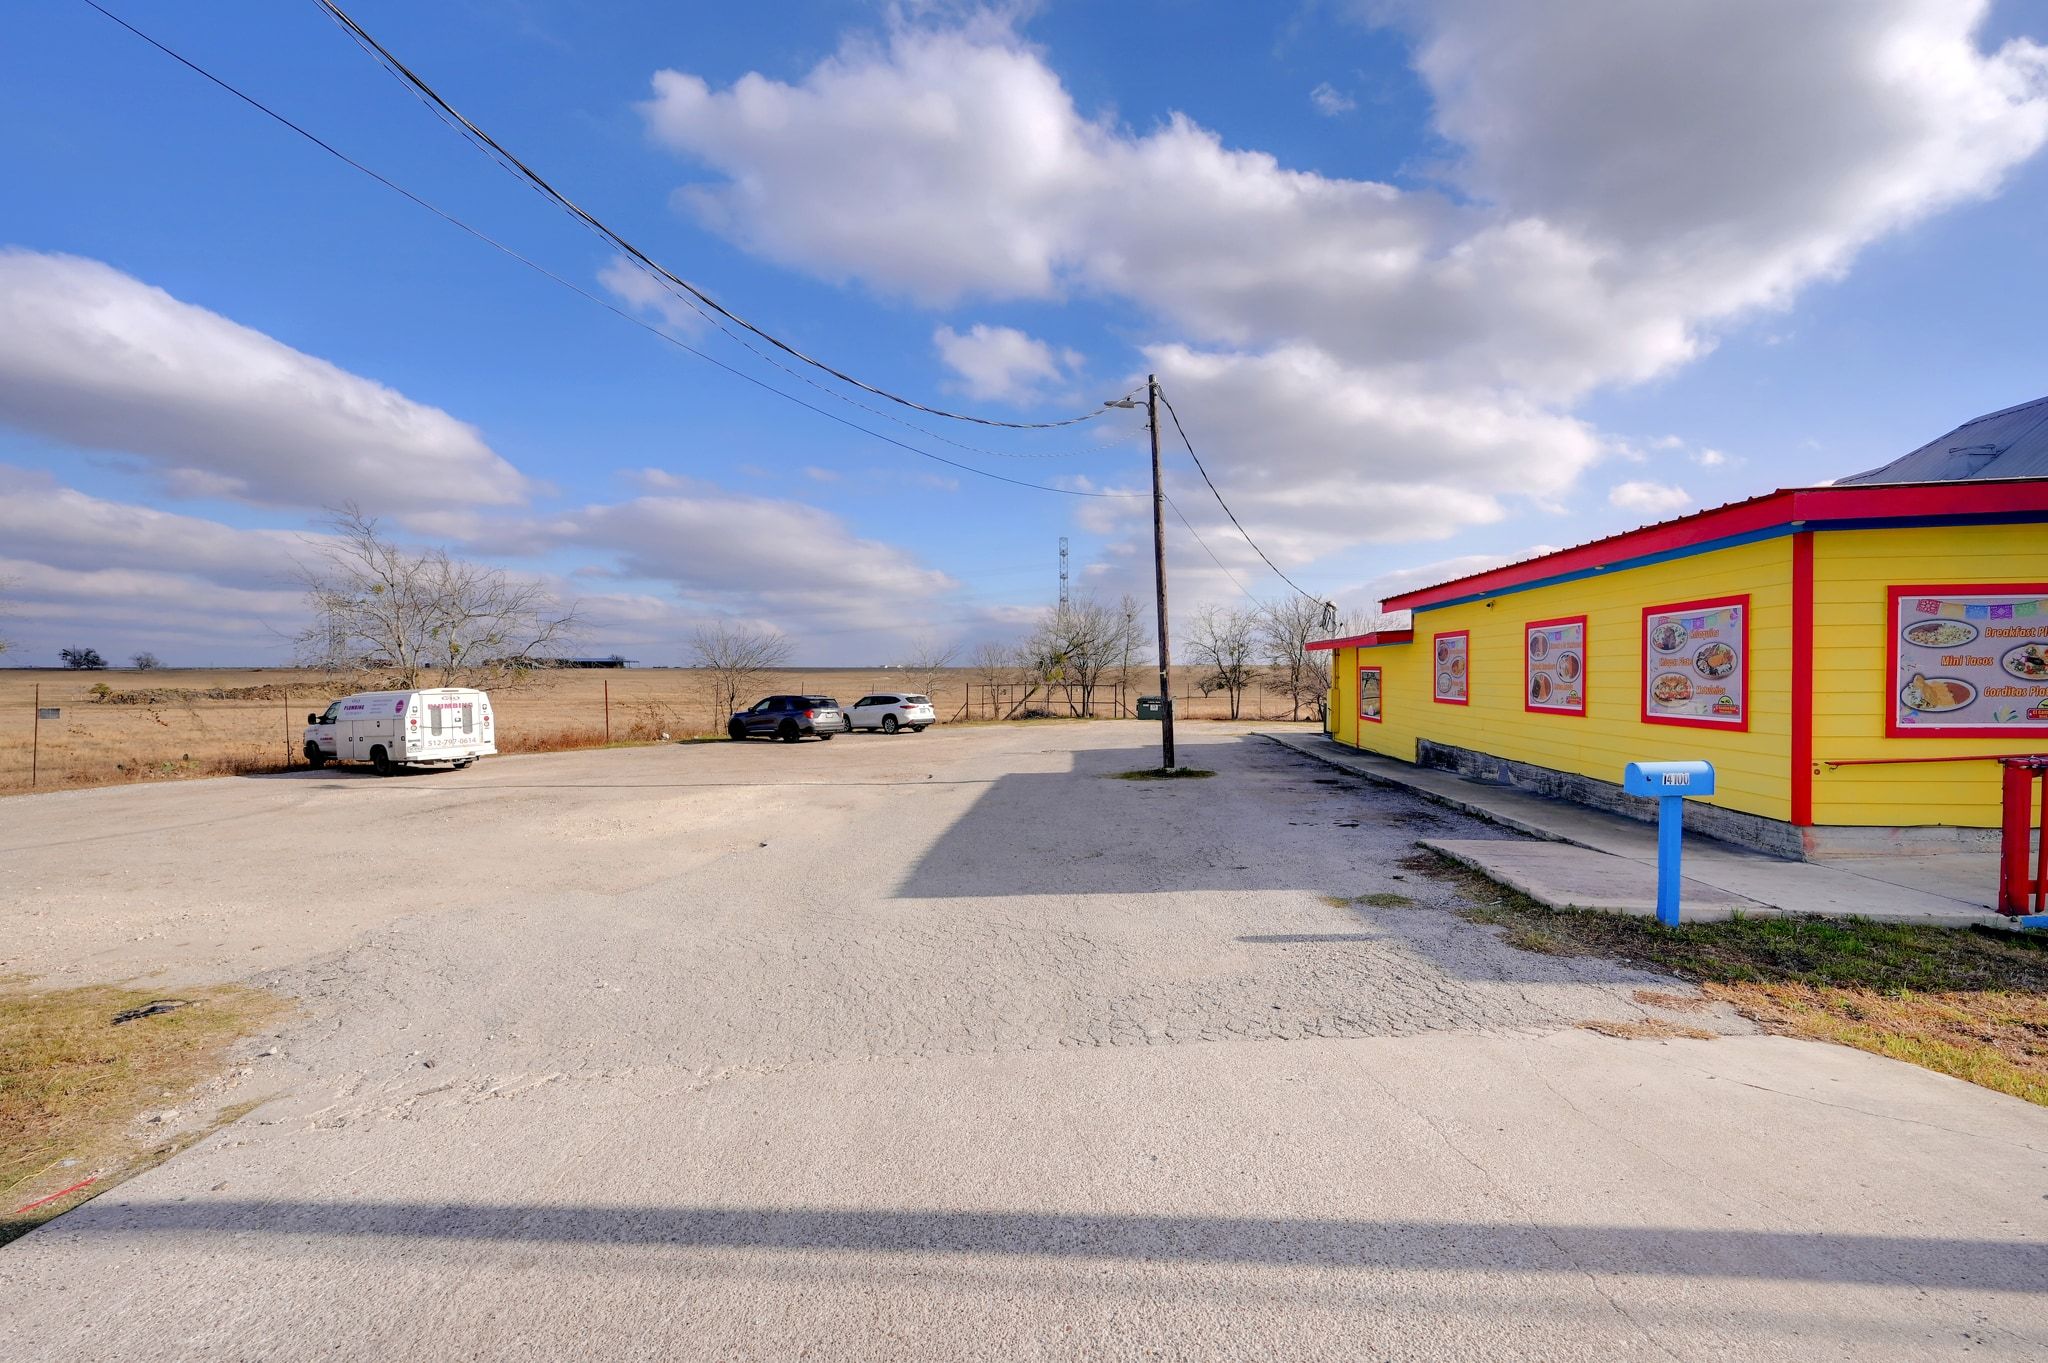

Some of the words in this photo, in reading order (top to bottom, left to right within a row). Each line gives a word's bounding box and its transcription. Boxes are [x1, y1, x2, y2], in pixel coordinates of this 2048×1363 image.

[1985, 626, 2036, 638] Breakfast
[2037, 626, 2048, 638] Pl
[1941, 655, 1964, 667] Mini
[1966, 656, 1994, 667] Tacos
[1984, 686, 2027, 697] Gorditas
[428, 702, 473, 711] PLUMBING
